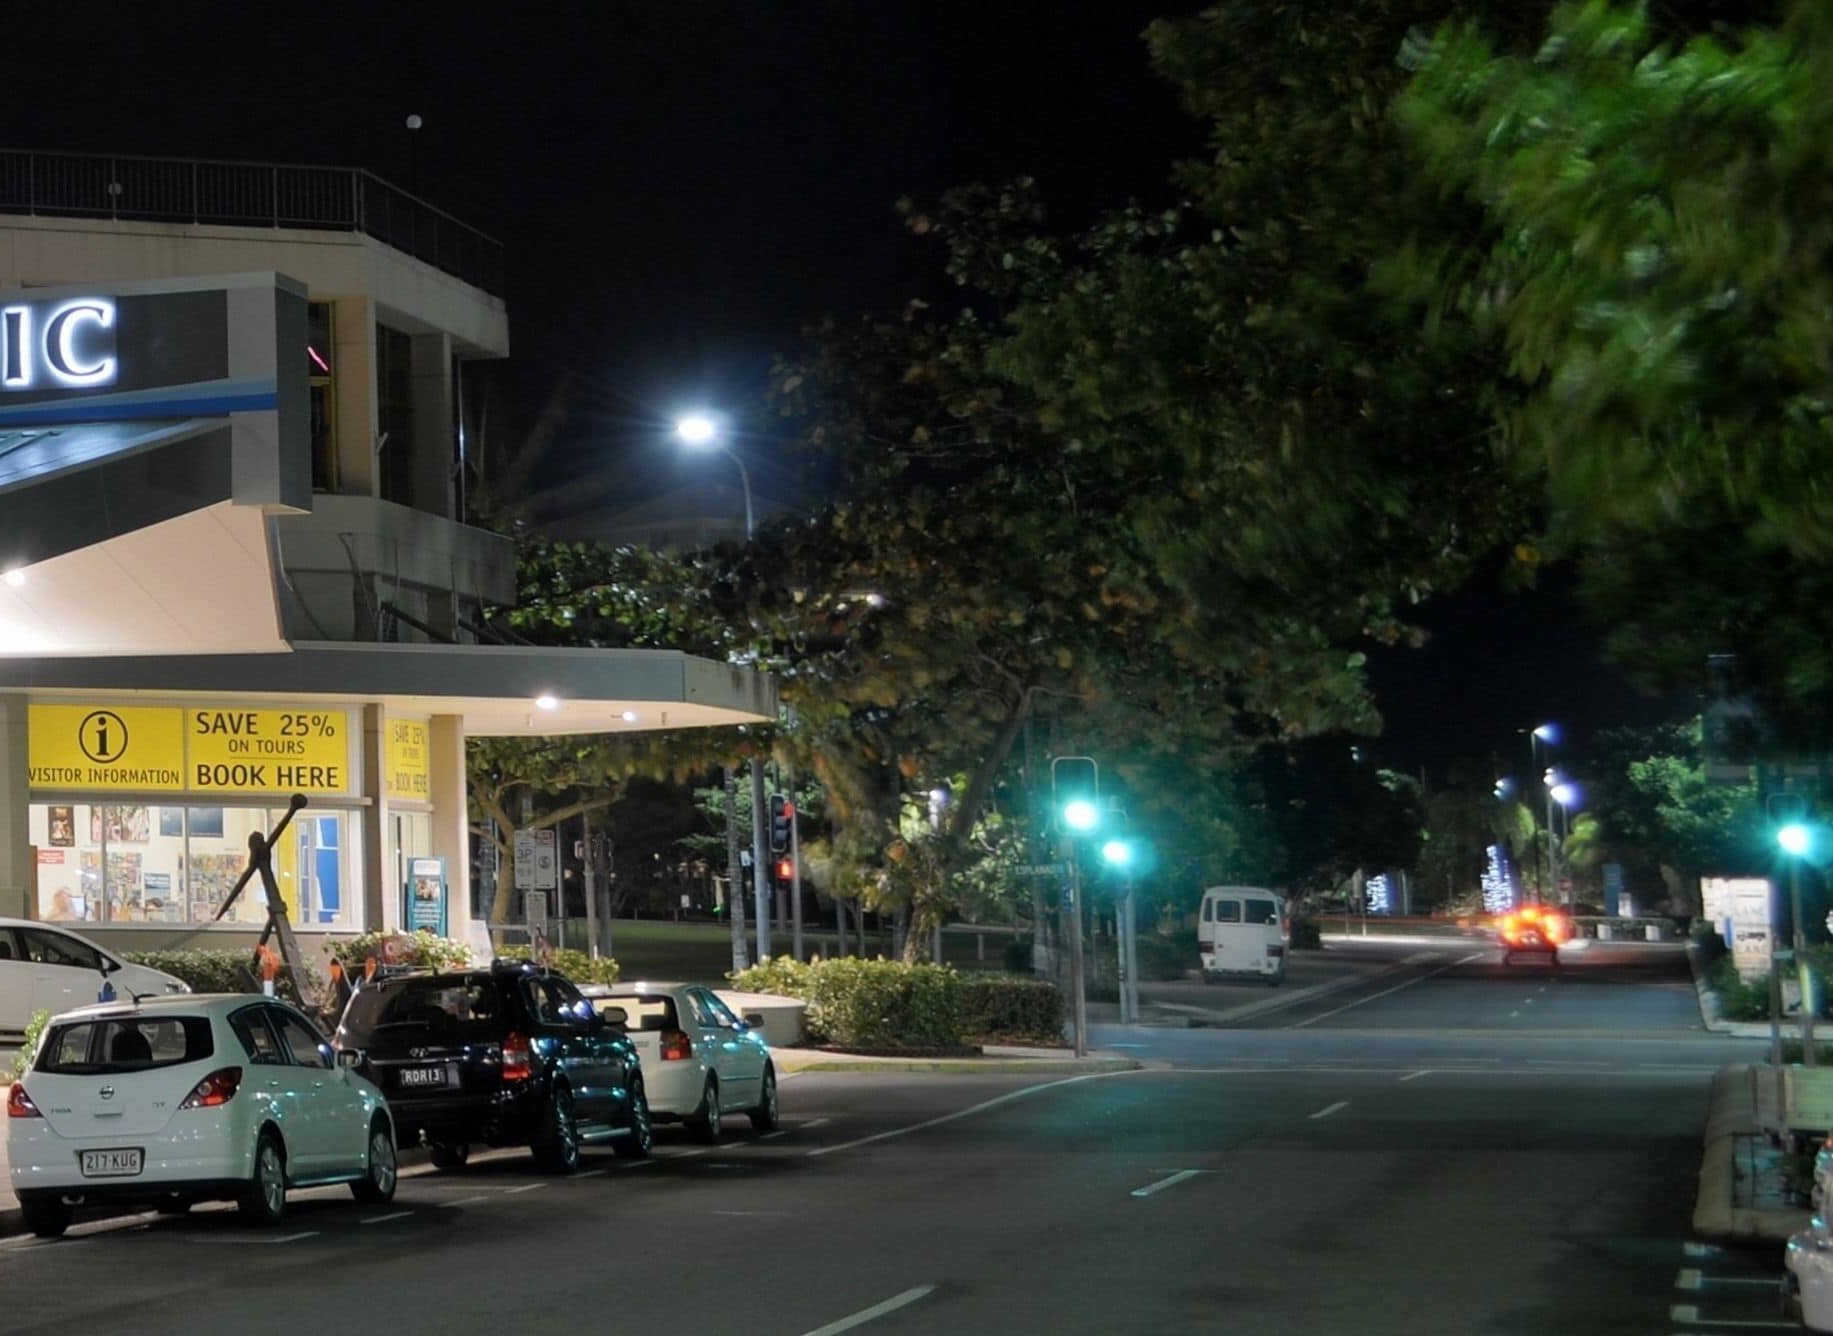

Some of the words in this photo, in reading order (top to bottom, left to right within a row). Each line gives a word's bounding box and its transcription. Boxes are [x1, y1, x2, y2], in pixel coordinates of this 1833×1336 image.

[196, 711, 258, 735] SAVE
[280, 714, 335, 737] 25%
[228, 739, 249, 753] ON
[256, 740, 305, 755] TOURS
[28, 767, 82, 783] VISITOR
[88, 768, 180, 785] INFORMATION
[196, 764, 267, 786] BOOK
[277, 765, 339, 788] HERE
